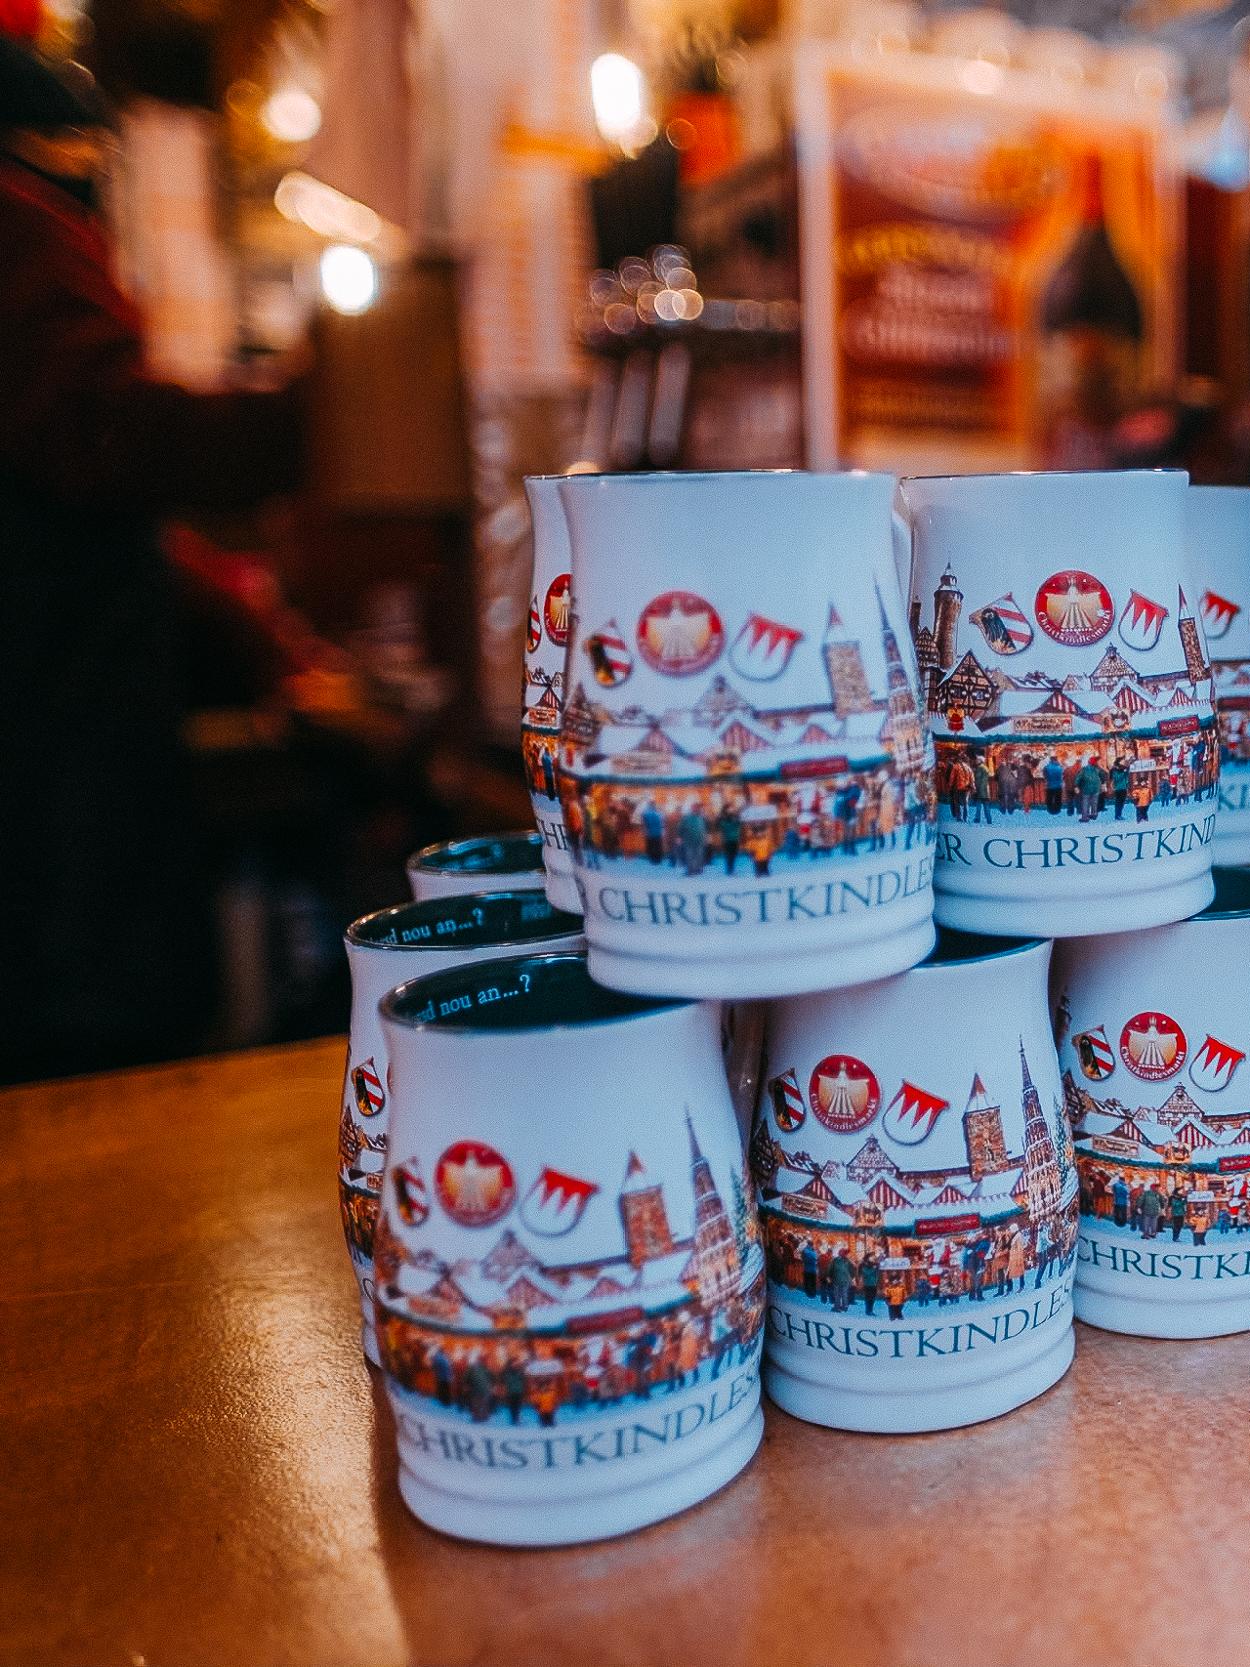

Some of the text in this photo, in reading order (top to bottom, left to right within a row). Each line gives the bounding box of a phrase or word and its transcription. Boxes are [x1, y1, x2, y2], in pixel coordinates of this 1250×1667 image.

[983, 813, 1217, 869] CHRISTKIND
[598, 856, 933, 926] CHRISTKINDLE
[439, 994, 472, 1016] nou
[768, 1282, 1070, 1358] CHRISTKINDLE
